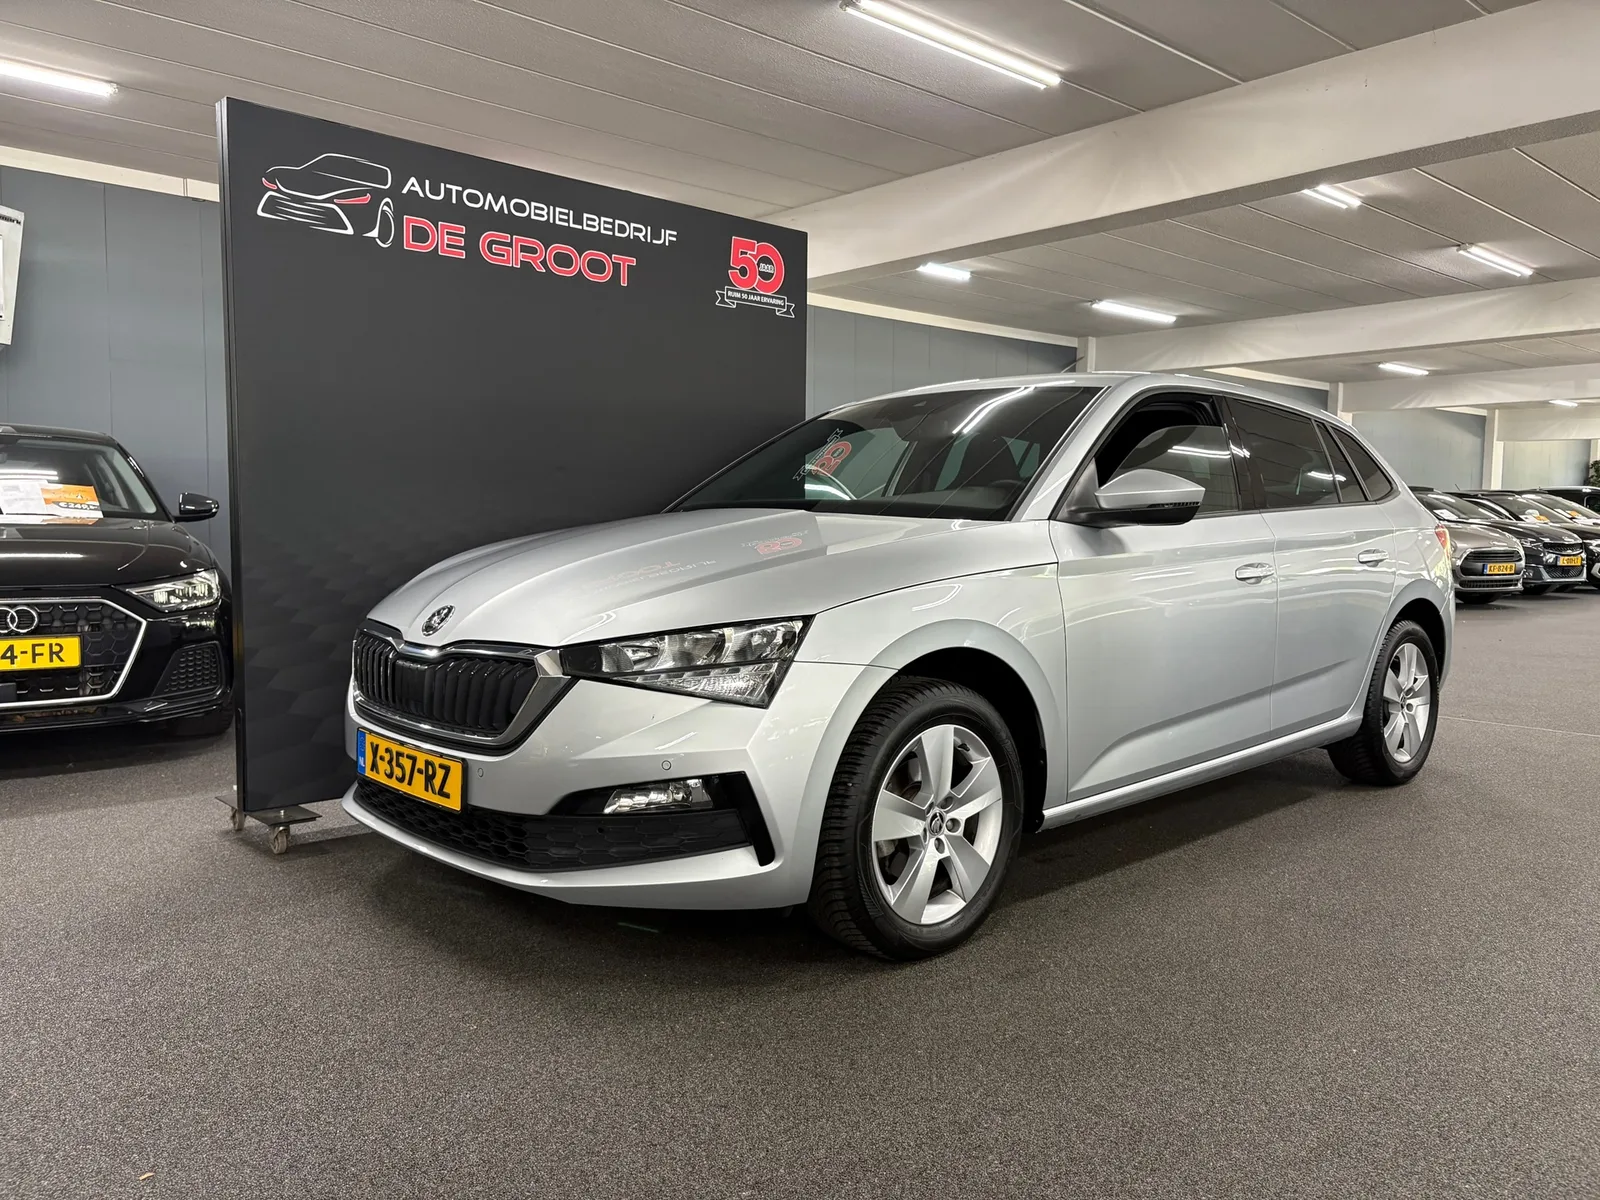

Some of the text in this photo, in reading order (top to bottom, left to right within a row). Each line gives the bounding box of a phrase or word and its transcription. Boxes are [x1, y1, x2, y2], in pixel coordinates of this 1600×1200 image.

[401, 176, 678, 246] AUTOMOBIELBEDRIJF
[403, 215, 637, 287] DE GROOT
[728, 236, 785, 295] 50
[728, 290, 741, 299] RUIM
[748, 294, 761, 302] JAAR
[760, 297, 784, 306] ERVARING
[0, 643, 65, 665] 4-FR
[370, 741, 451, 799] X-357-RZ
